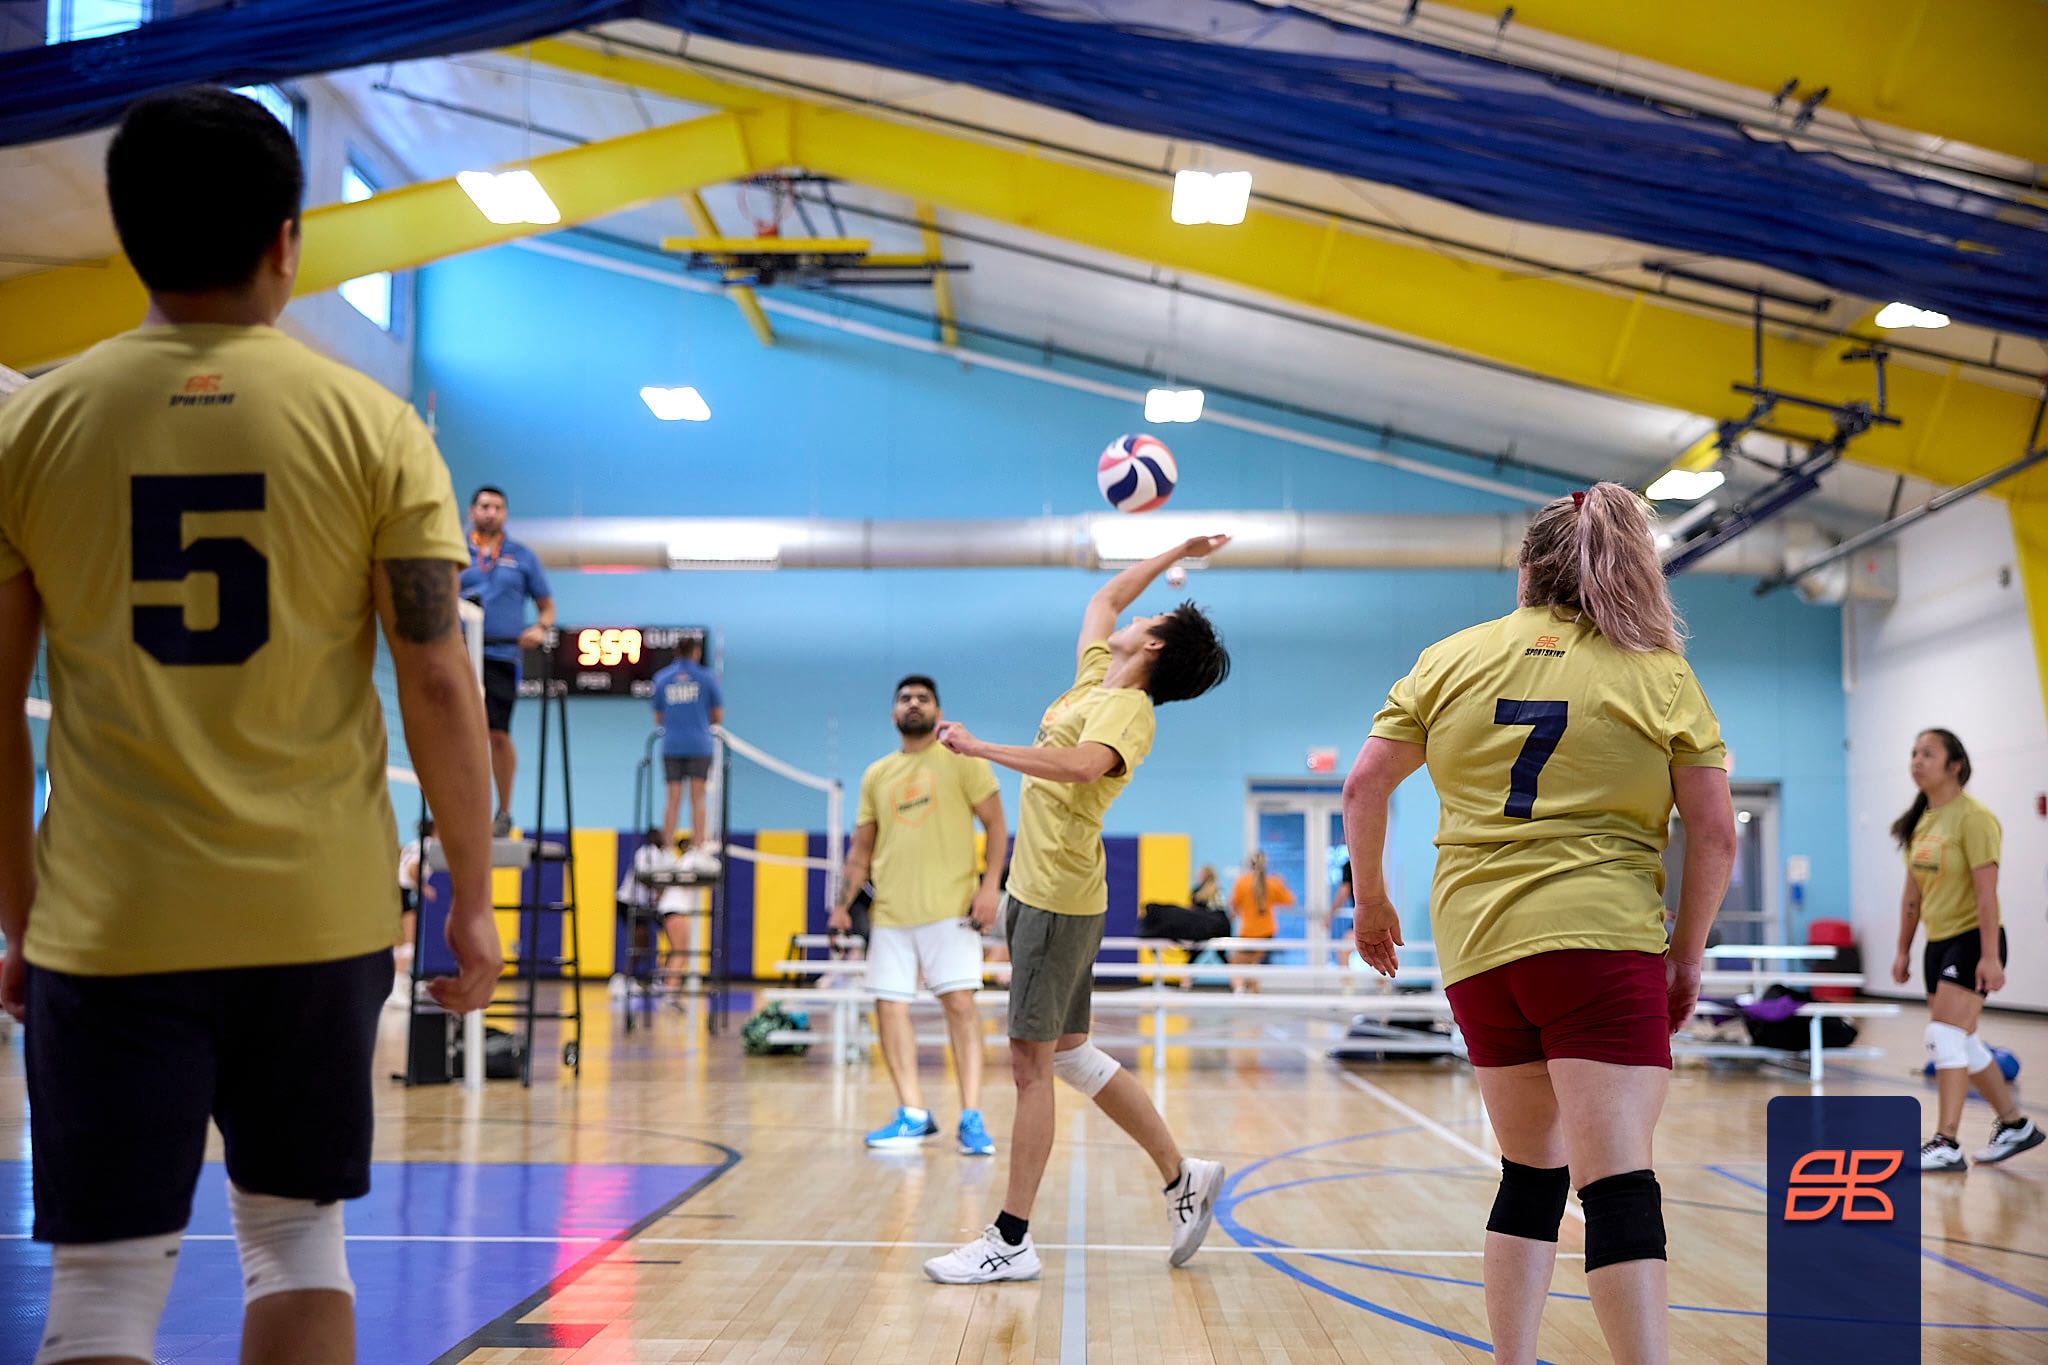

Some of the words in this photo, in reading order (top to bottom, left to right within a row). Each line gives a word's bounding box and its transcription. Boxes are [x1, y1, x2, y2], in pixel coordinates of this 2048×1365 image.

[131, 472, 269, 666] 5
[1525, 648, 1566, 658] SPORTSKIND
[1494, 698, 1569, 819] 7
